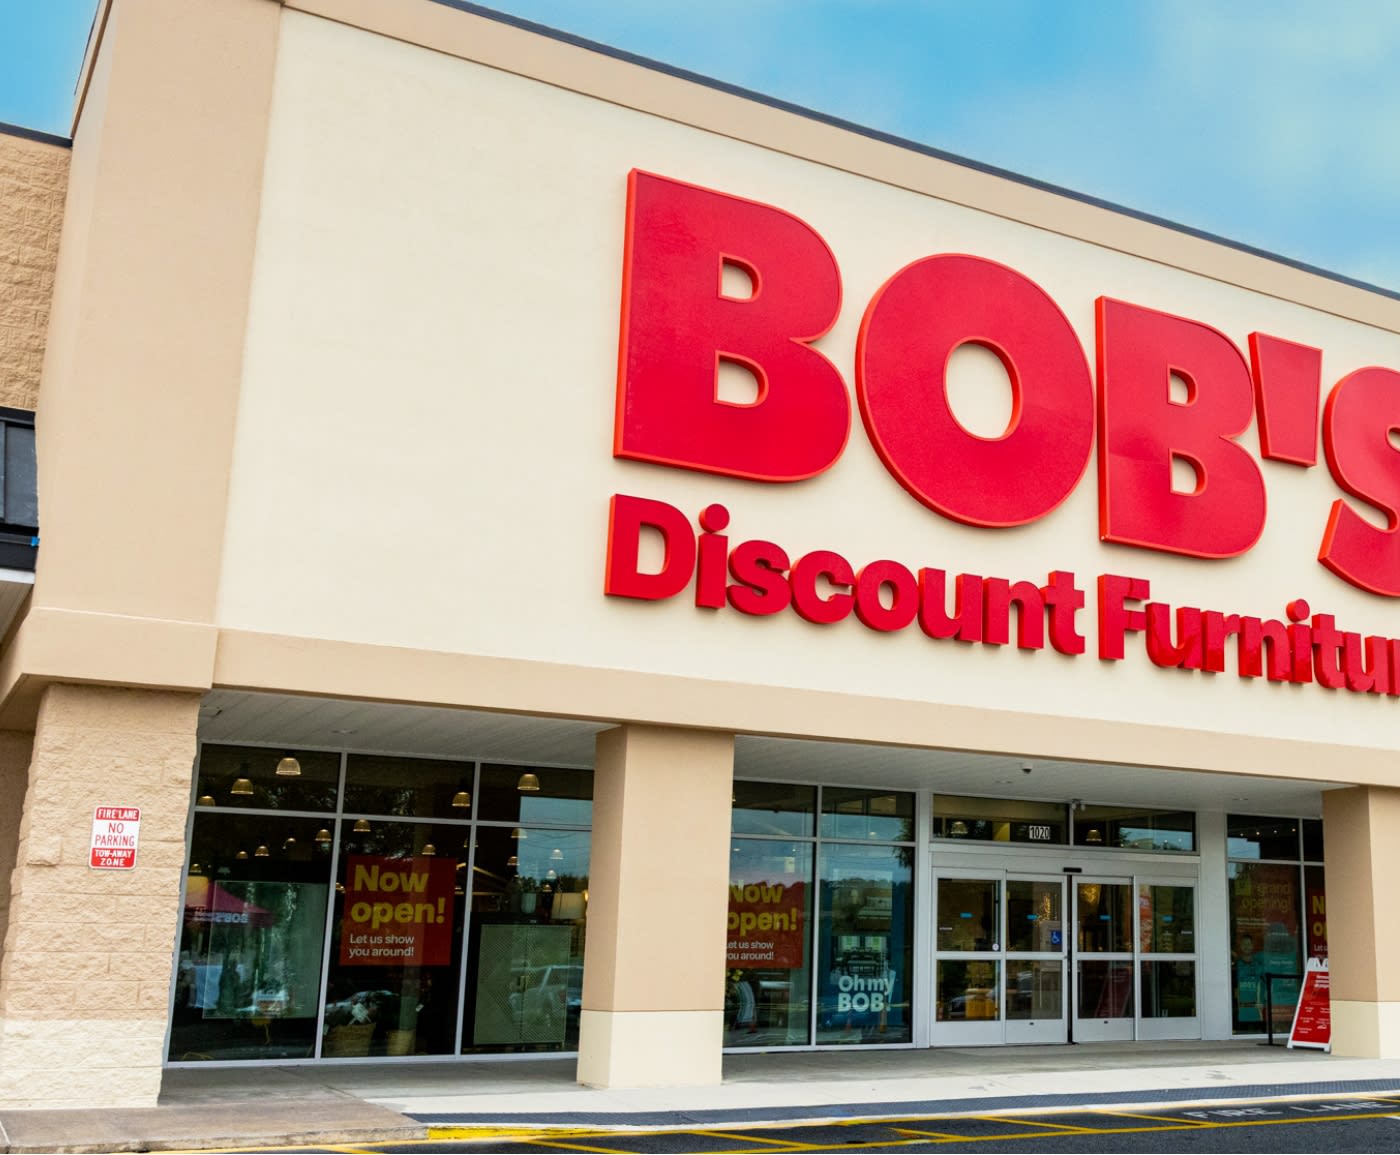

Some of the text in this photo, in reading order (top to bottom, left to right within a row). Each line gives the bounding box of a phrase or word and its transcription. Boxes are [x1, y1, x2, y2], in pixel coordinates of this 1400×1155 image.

[604, 492, 1086, 656] Discount
[98, 809, 137, 819] FIRE LANE
[108, 823, 124, 833] NO
[95, 835, 134, 846] PARKING
[100, 858, 124, 866] ZONE
[353, 864, 430, 893] Now
[350, 897, 447, 930] open!
[727, 907, 798, 937] open!
[349, 934, 415, 945] Let us show
[739, 941, 750, 949] us
[751, 941, 774, 949] show
[348, 946, 415, 959] you around!
[741, 951, 775, 961] around!
[838, 970, 896, 996] Oh my
